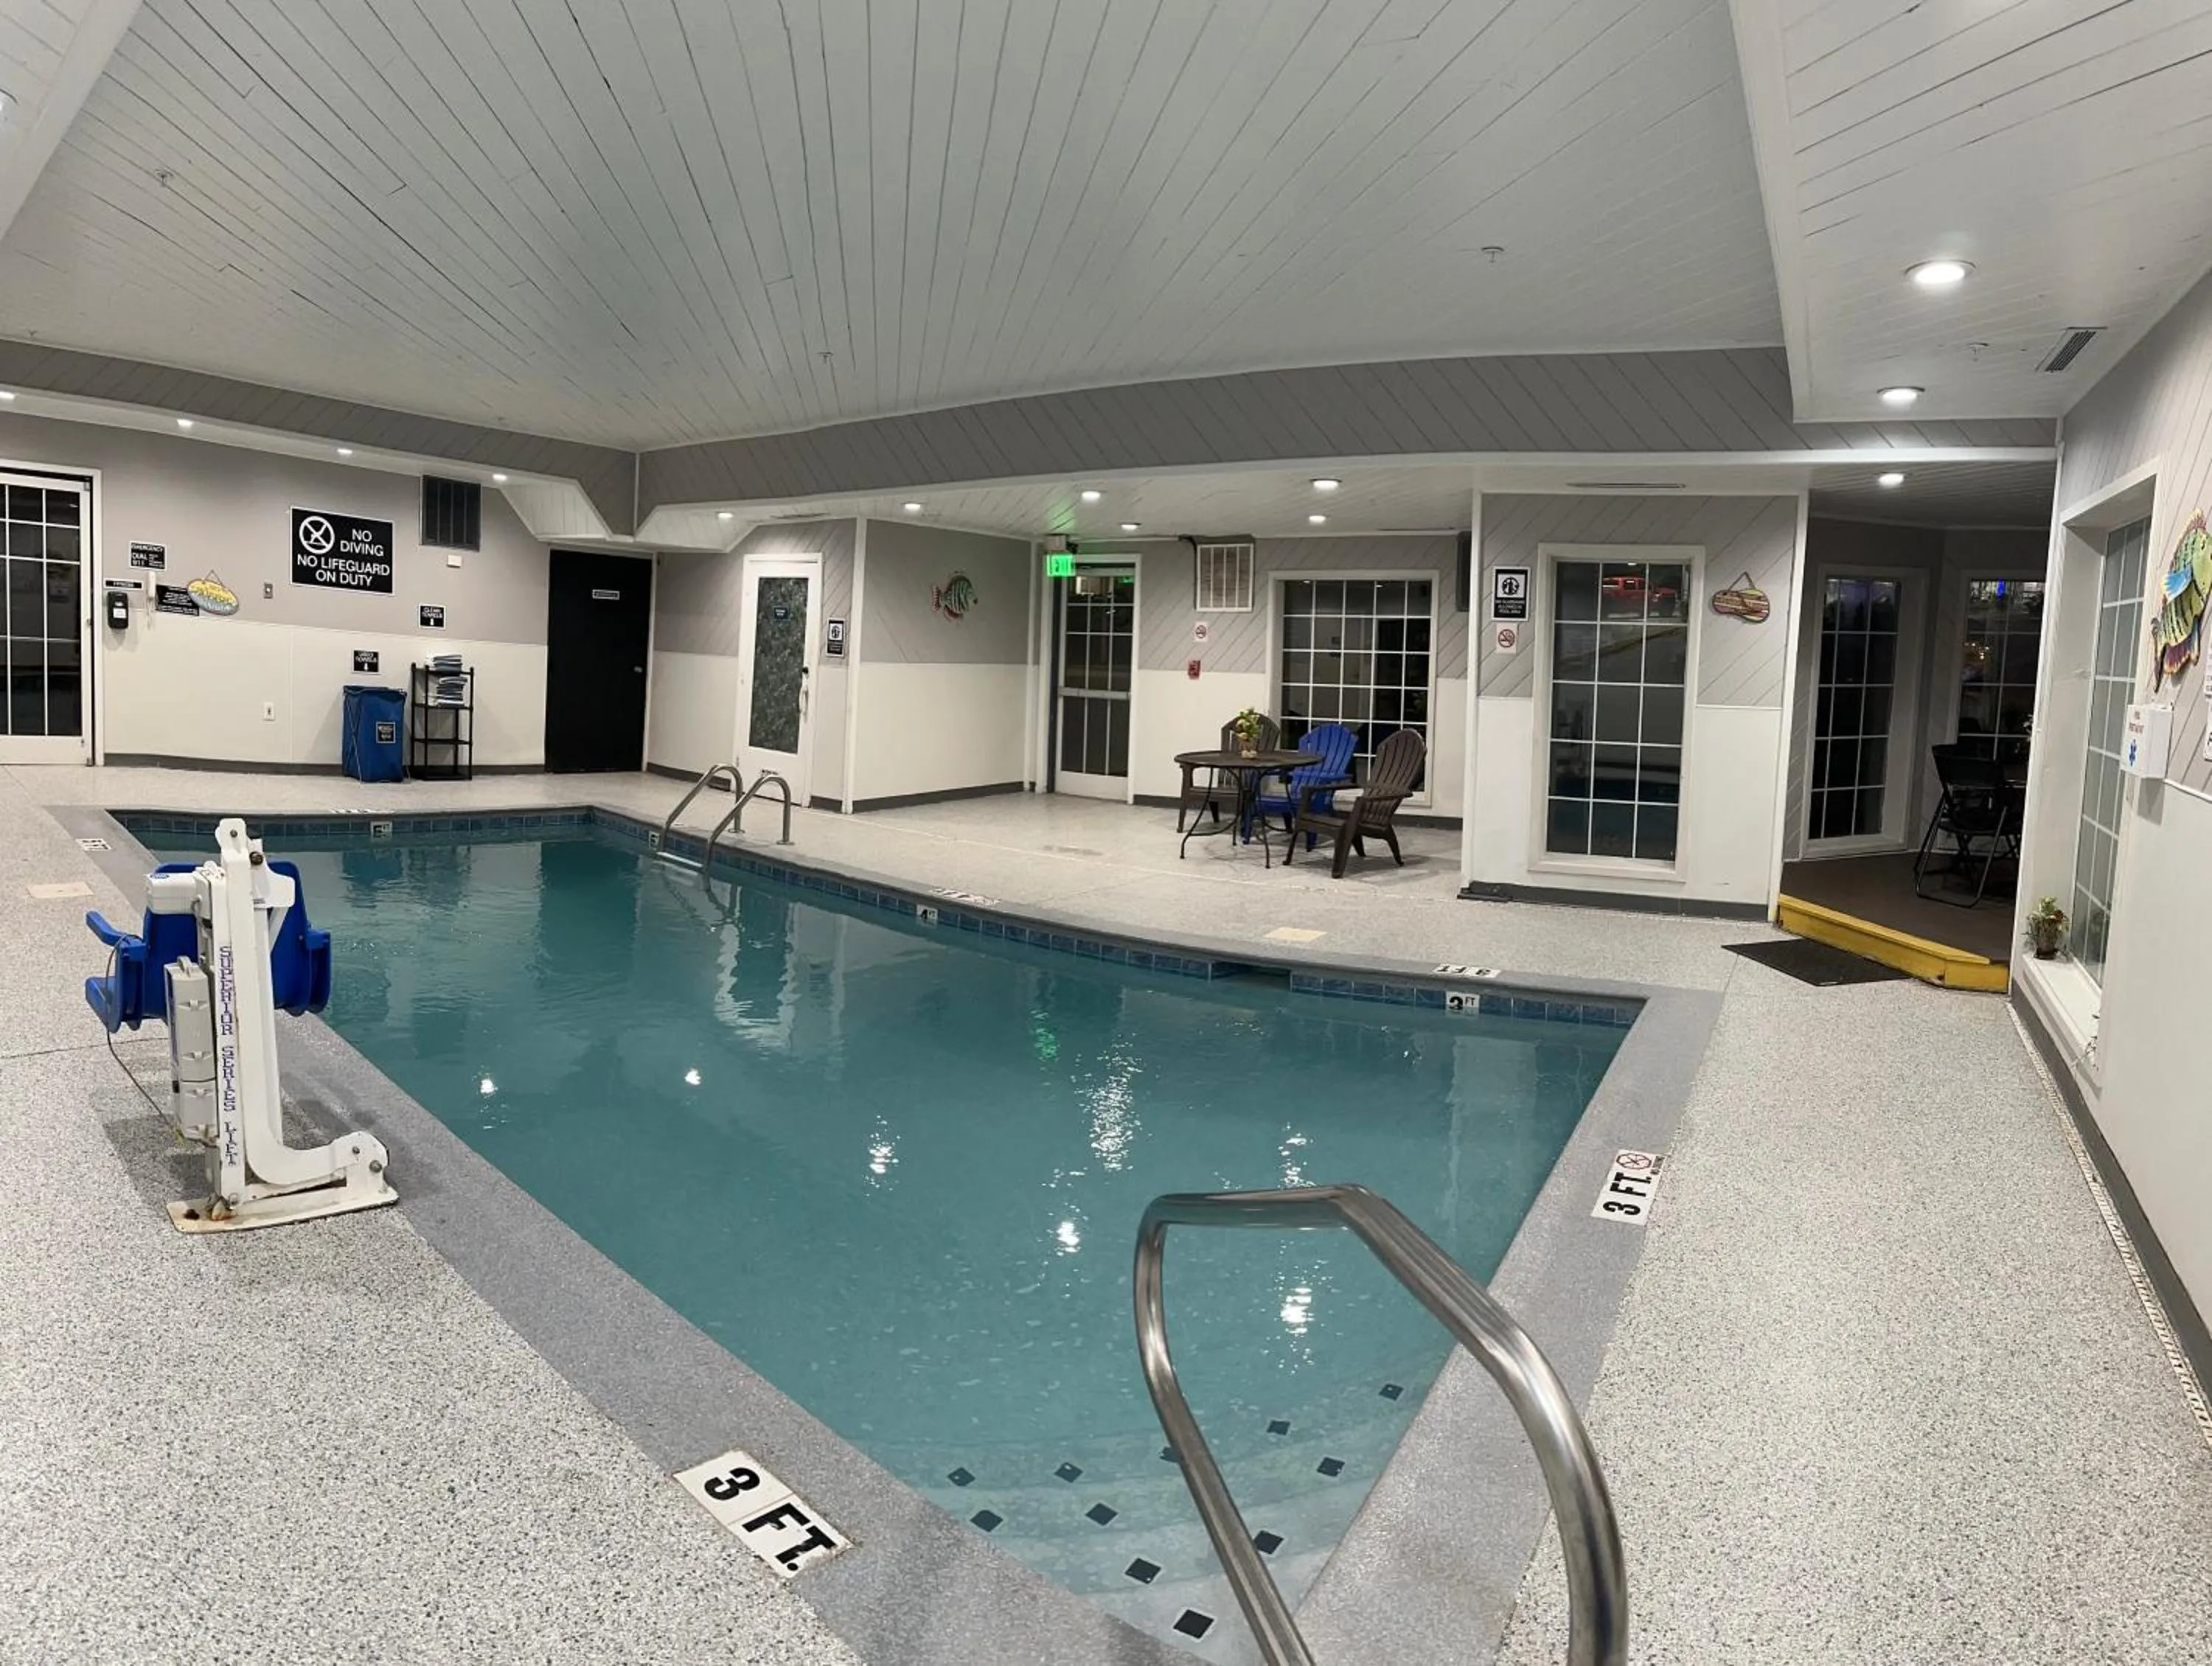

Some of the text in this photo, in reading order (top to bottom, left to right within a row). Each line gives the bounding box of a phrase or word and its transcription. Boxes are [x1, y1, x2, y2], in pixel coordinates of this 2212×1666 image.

[352, 529, 372, 542] NO
[340, 540, 383, 557] DIVING
[297, 554, 390, 575] NO LIFEGUARD
[1051, 555, 1074, 575] EXIT
[316, 569, 372, 586] ON DUTY
[220, 946, 237, 1165] SUPERIOR SERIES LIFT
[1602, 1201, 1641, 1216] 3
[704, 1467, 837, 1571] 3 FT.
